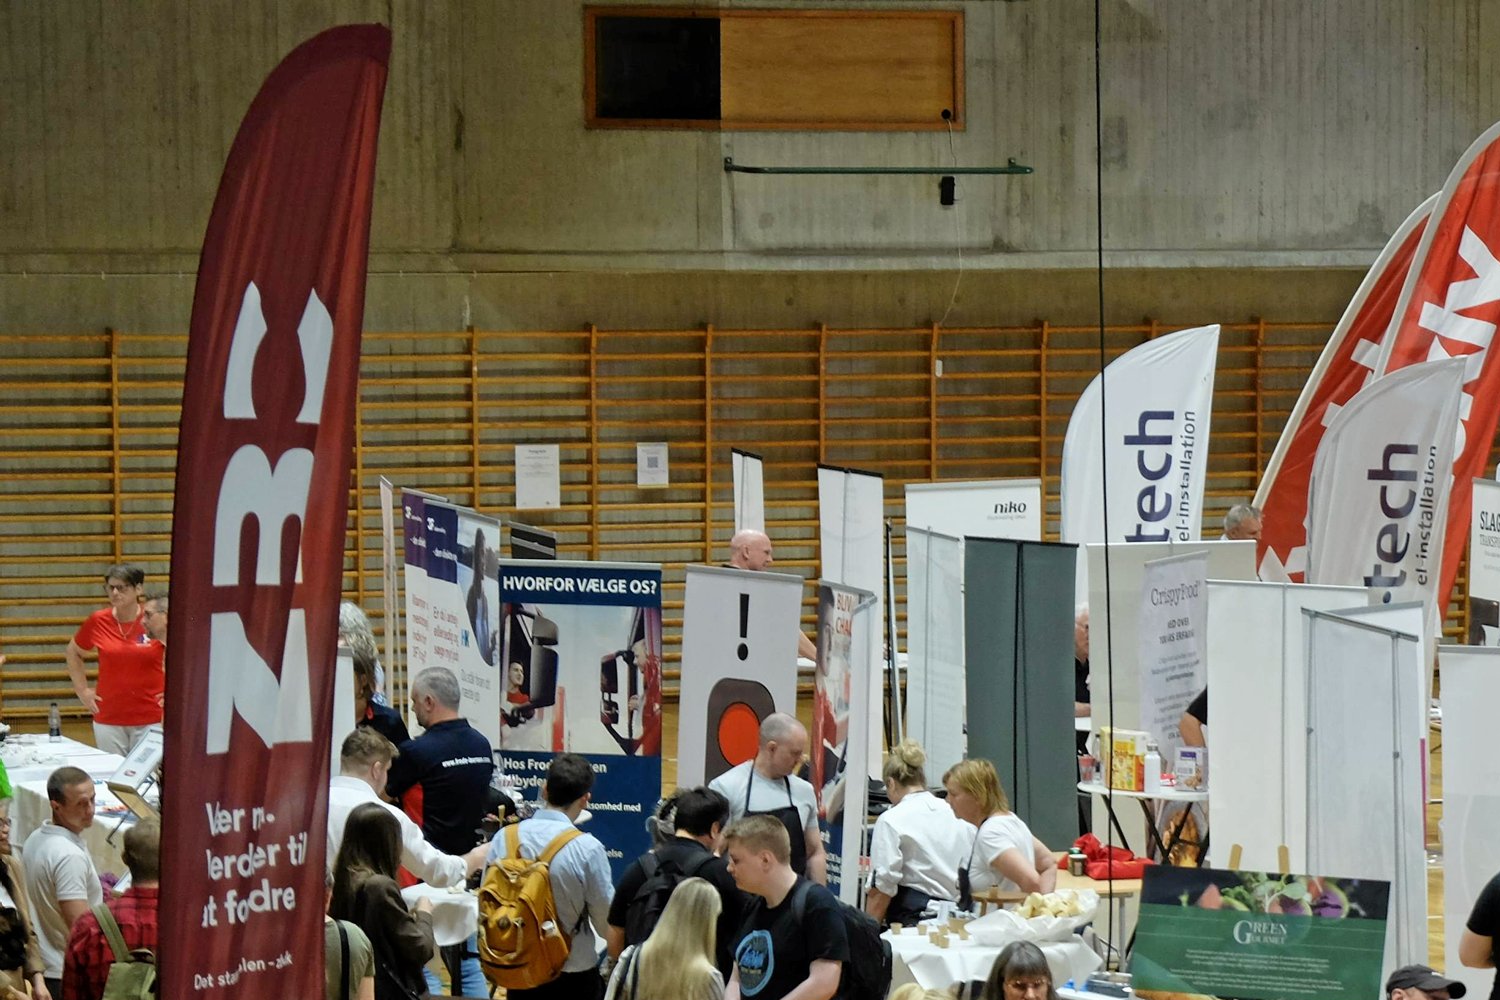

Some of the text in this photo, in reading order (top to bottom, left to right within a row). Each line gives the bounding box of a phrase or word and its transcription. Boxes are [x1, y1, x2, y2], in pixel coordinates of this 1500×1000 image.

[1176, 411, 1195, 541] el-installation
[994, 501, 1027, 514] niko
[1414, 446, 1436, 585] el-installation
[503, 576, 657, 594] HVORFOR VÆLGE OS?
[504, 758, 525, 771] Hos
[586, 801, 642, 812] ksomhed med
